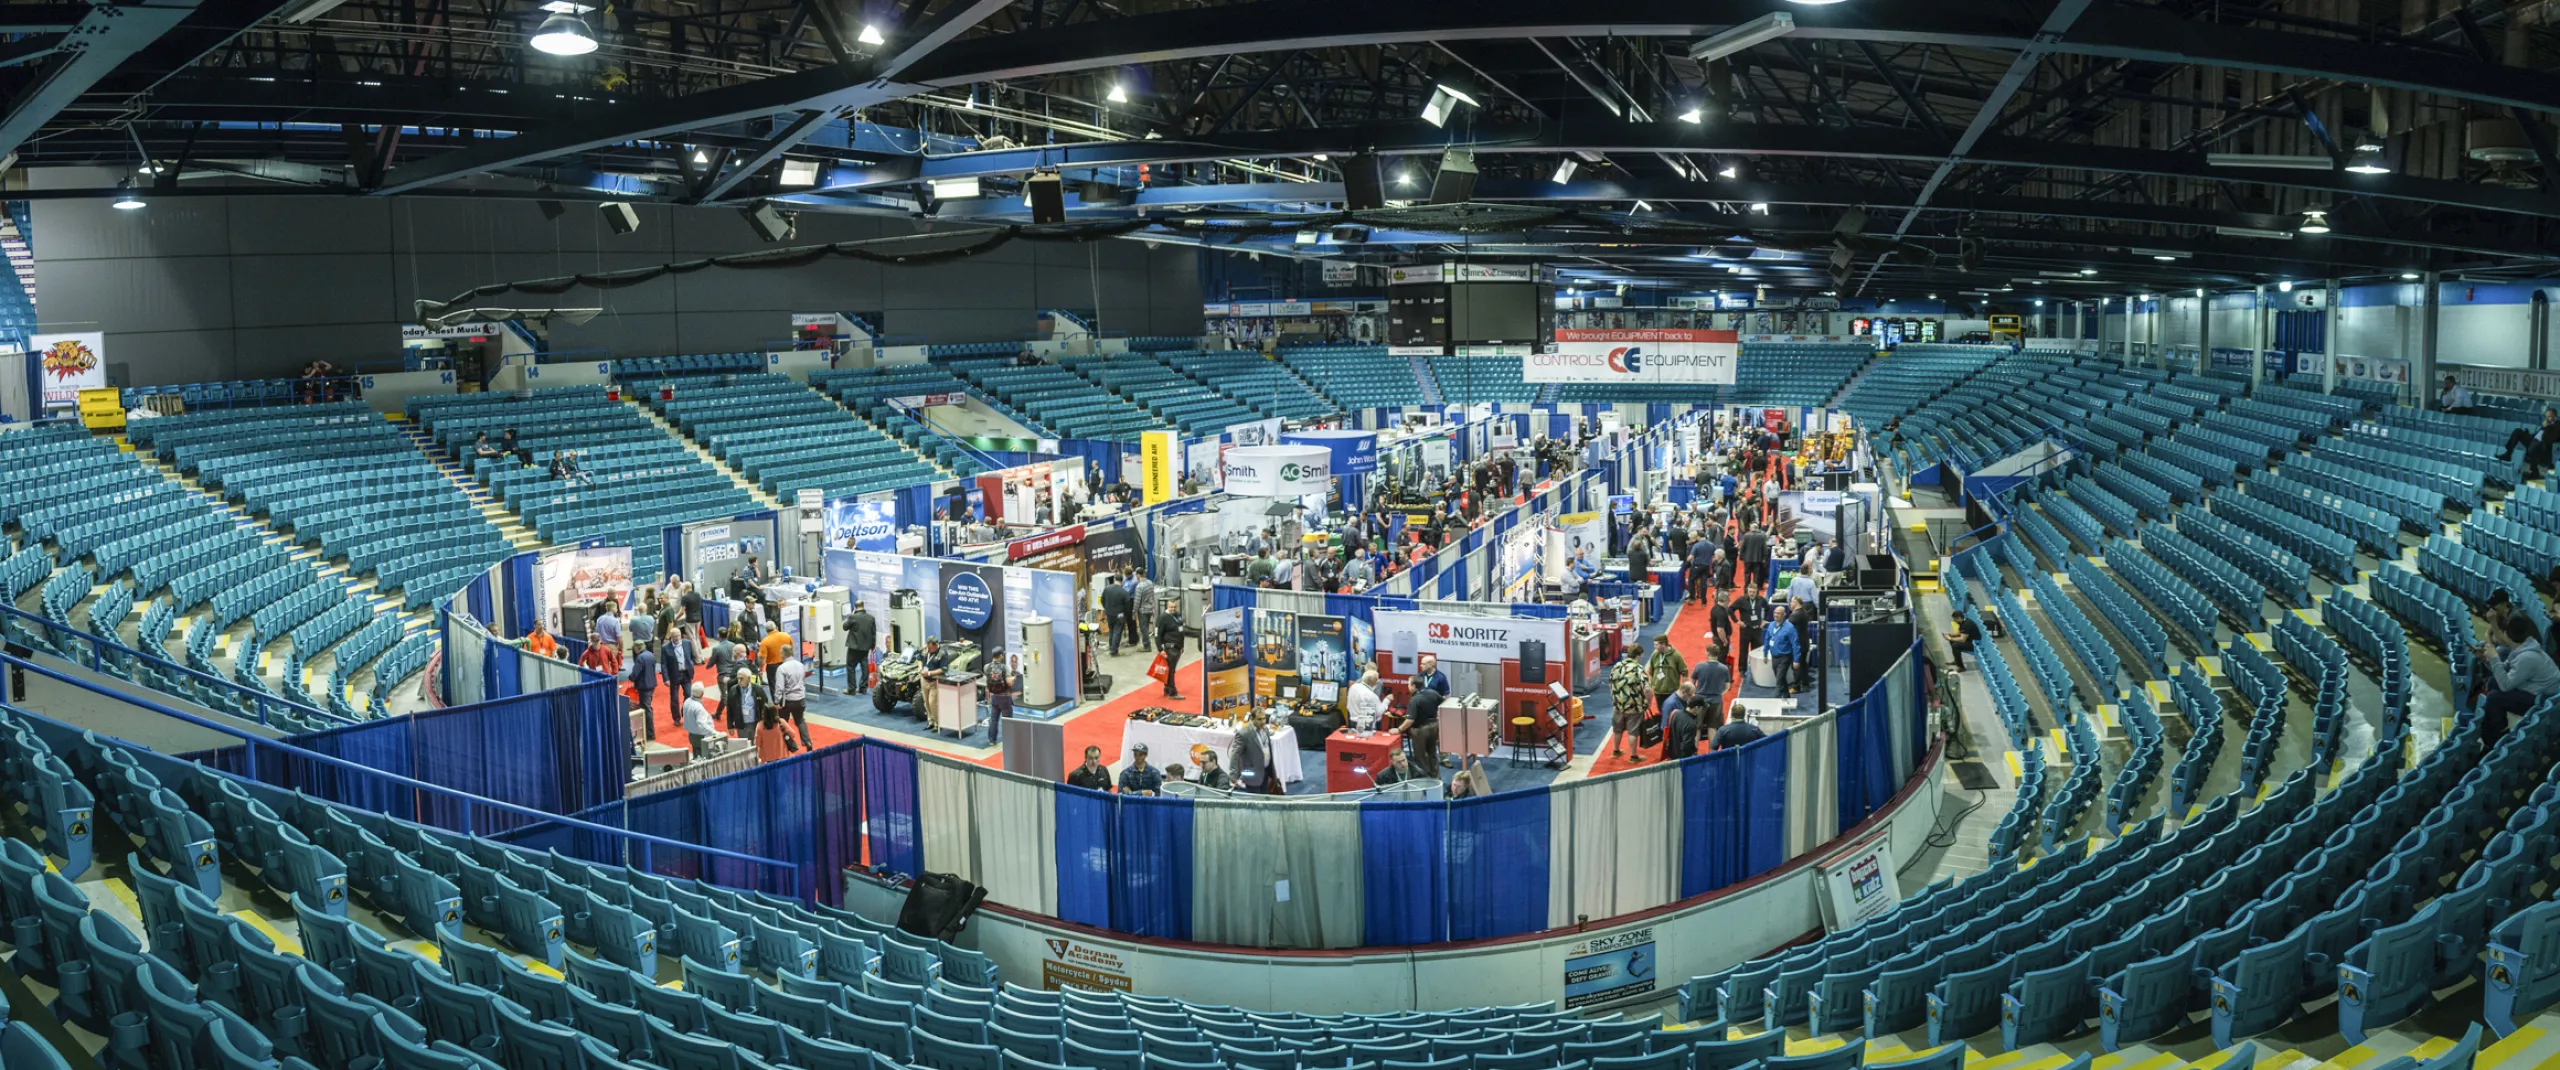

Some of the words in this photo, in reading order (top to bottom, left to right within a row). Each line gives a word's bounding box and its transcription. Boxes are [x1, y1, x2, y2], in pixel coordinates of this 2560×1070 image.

[457, 324, 482, 333] Music
[1567, 331, 1580, 340] We
[1581, 332, 1611, 342] brought
[1611, 331, 1663, 340] EQUIPMENT
[1664, 332, 1682, 340] back
[1684, 332, 1693, 340] to
[769, 353, 779, 365] 13
[820, 351, 830, 362] 12
[875, 348, 884, 359] 12
[1533, 354, 1604, 366] CONTROLS
[1645, 354, 1727, 367] EQUIPMENT
[526, 366, 540, 379] 14
[597, 362, 609, 375] 13
[359, 376, 375, 389] 15
[439, 370, 454, 384] 14
[2461, 369, 2518, 391] DELIVERING
[1347, 455, 1364, 465] John
[837, 524, 888, 541] Dettson
[966, 590, 989, 600] Outlander
[1453, 627, 1508, 642] NORITZ
[1429, 638, 1459, 646] TANKLESS
[1459, 639, 1480, 648] WATER
[1481, 641, 1508, 650] HEATERS
[1590, 936, 1615, 949] SKY
[1619, 928, 1653, 943] ZONE
[1590, 940, 1634, 954] TRAMPOLINE
[1635, 936, 1652, 944] PARK
[1068, 950, 1124, 968] Academy
[1074, 945, 1118, 960] Dornan
[1046, 960, 1090, 980] Motorcycle
[1098, 974, 1129, 988] Spyder
[1568, 968, 1588, 978] COME
[1571, 975, 1587, 984] DEFY
